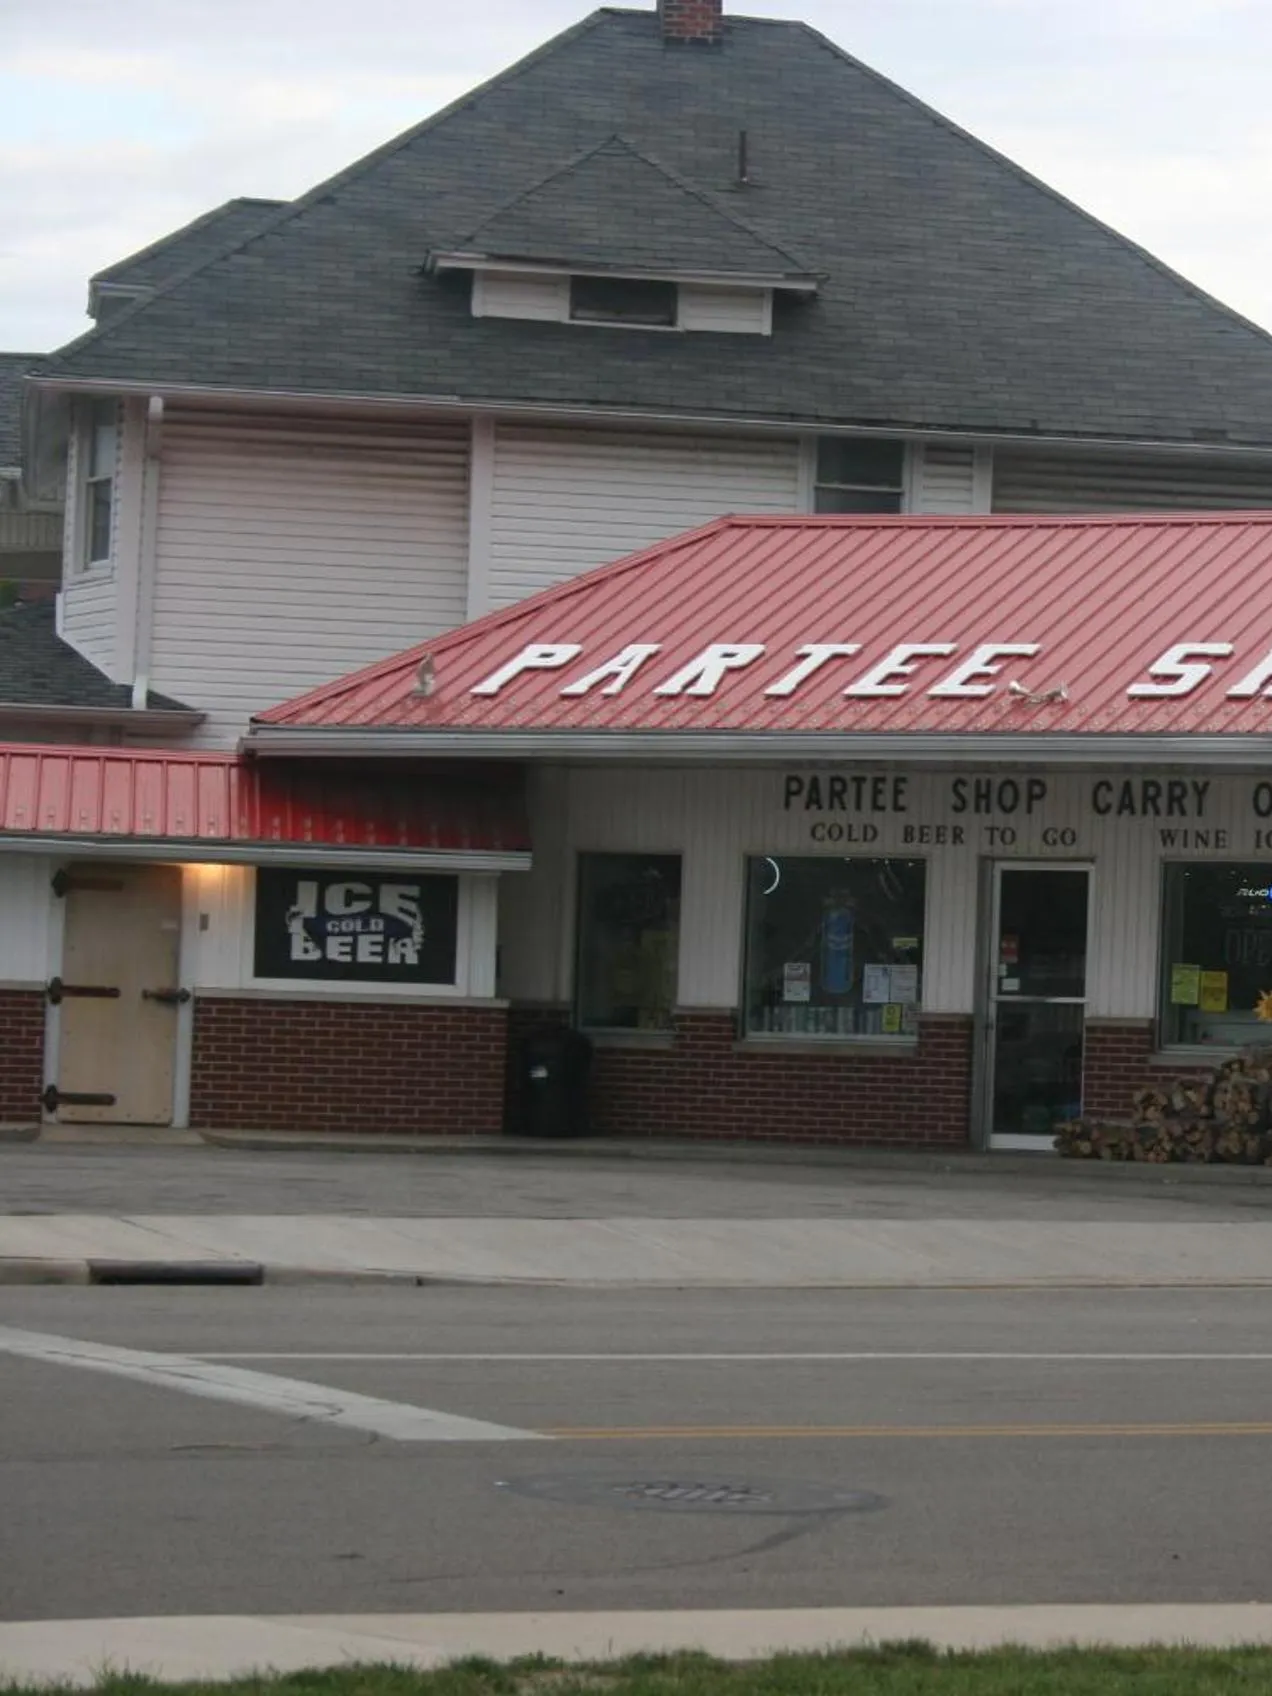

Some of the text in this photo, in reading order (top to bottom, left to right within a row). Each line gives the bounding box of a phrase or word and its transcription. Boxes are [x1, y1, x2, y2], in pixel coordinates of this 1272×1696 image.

[470, 643, 1041, 698] PARTEE
[784, 775, 908, 812] PARTEE
[951, 778, 1047, 814] SHOP
[1092, 780, 1210, 817] CARRY
[810, 822, 878, 843] COLD
[903, 824, 965, 845] BEER
[984, 826, 1017, 847] TO
[1042, 827, 1077, 847] GO
[1159, 829, 1229, 849] WINE
[292, 880, 422, 929] ICE
[326, 918, 385, 933] COLD
[289, 932, 420, 964] BEER
